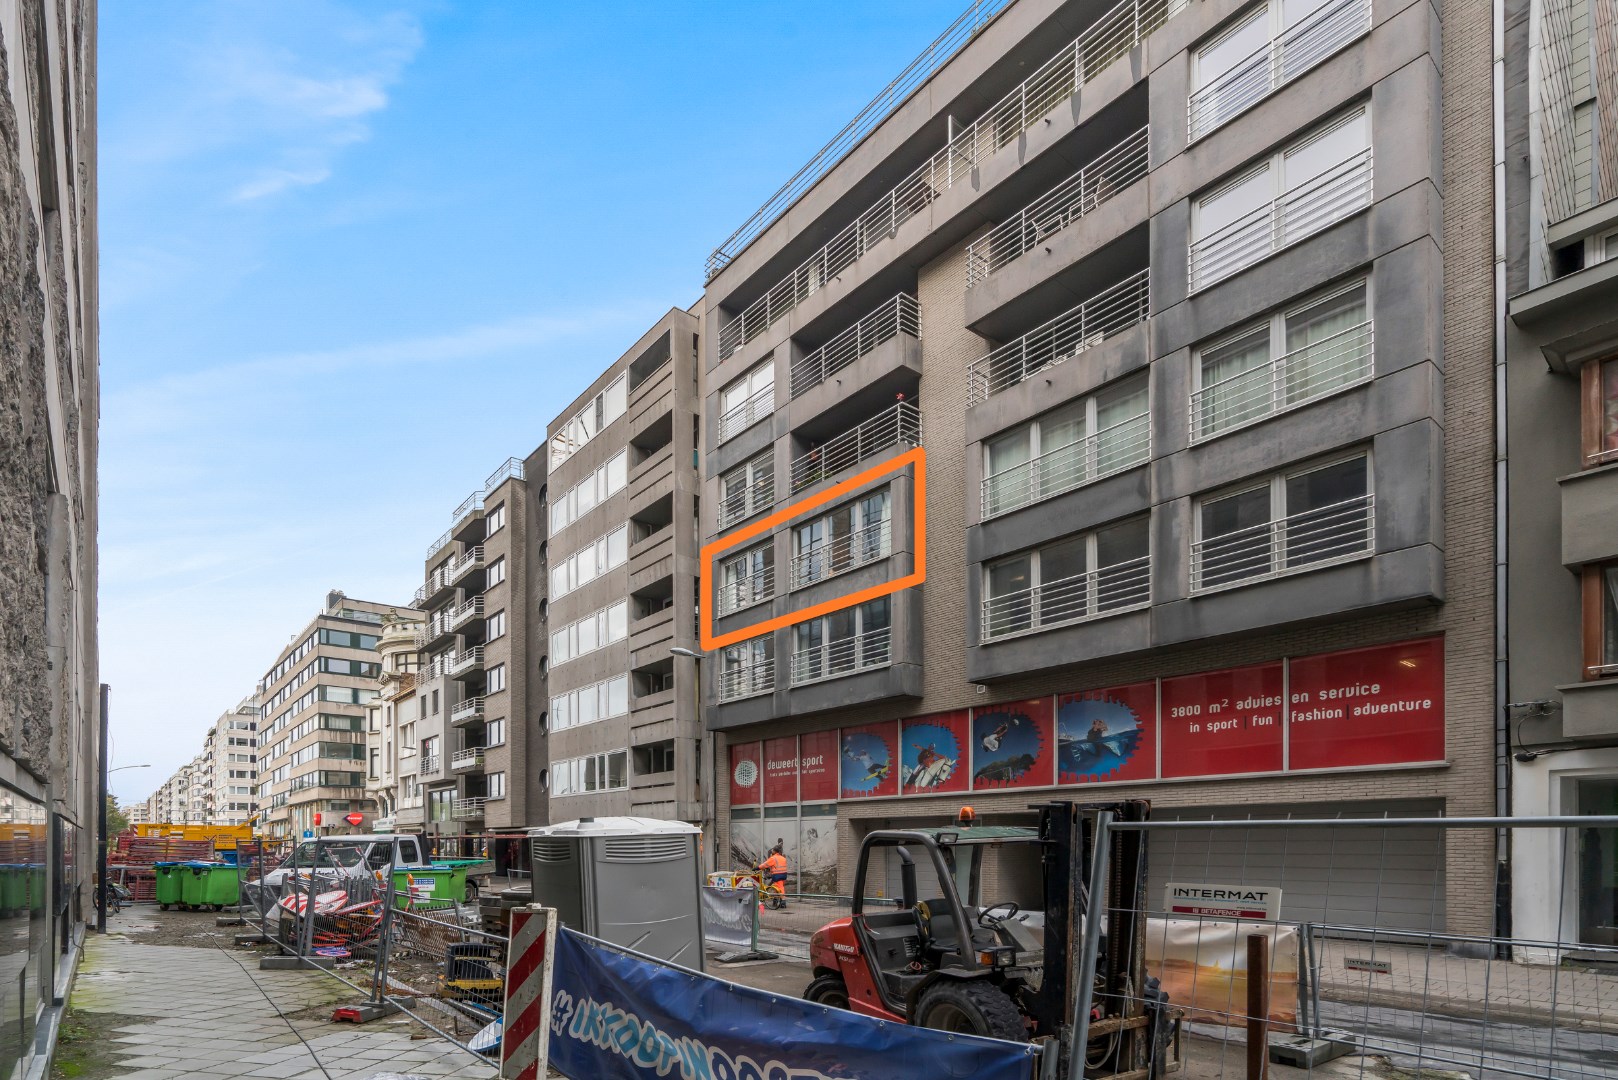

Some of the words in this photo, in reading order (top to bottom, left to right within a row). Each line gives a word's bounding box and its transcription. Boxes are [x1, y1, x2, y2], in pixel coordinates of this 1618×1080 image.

[1171, 704, 1201, 718] 3800
[1236, 695, 1282, 710] advies
[1291, 692, 1309, 704] en
[1319, 683, 1381, 701] service
[1189, 722, 1200, 733] in
[1206, 718, 1238, 734] sport
[1252, 715, 1273, 727] fun
[1291, 707, 1343, 723] fashion
[1353, 698, 1432, 716] adventure
[802, 754, 823, 769] sport
[1173, 888, 1268, 901] INTERMAT
[1200, 908, 1242, 917] BETAFENCE
